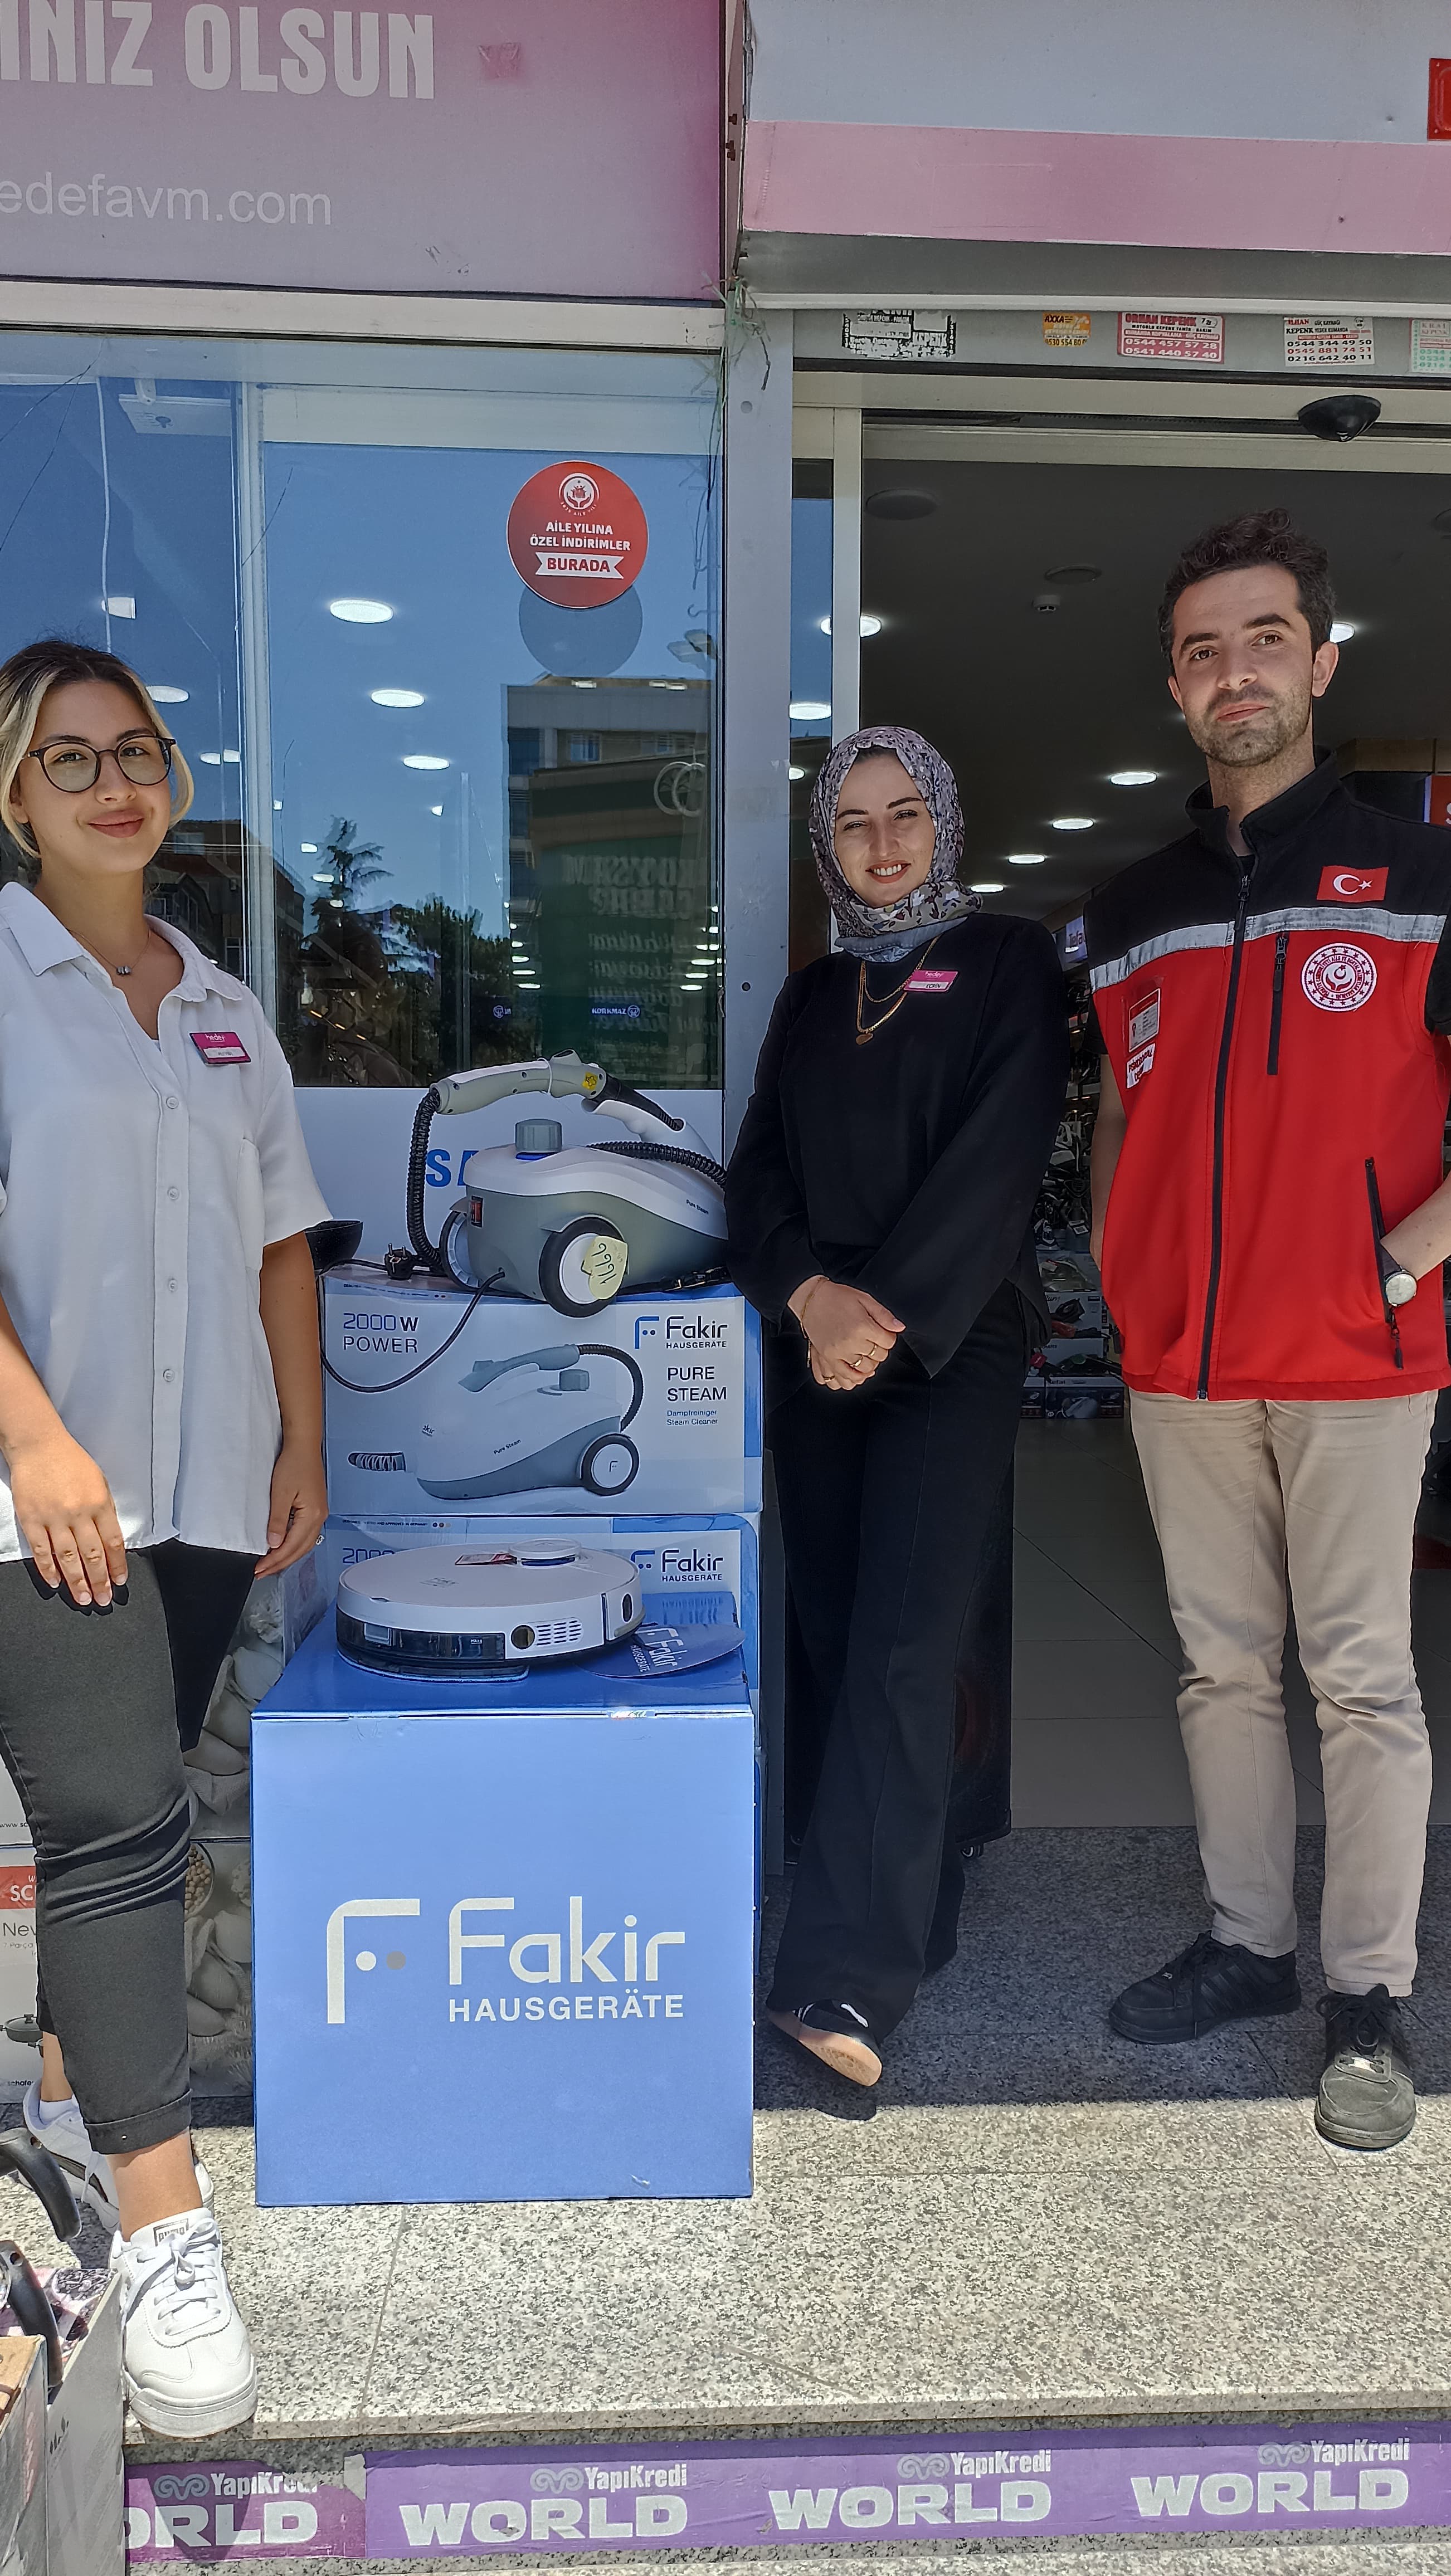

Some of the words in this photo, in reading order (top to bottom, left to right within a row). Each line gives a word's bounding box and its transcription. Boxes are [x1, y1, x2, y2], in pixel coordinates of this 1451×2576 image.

[184, 4, 435, 99] OLSUN
[546, 520, 572, 533] AİLE
[573, 522, 613, 535] YILINA
[530, 534, 559, 547] ÖZEL
[562, 535, 631, 551] İNDİRİMLER
[547, 558, 611, 573] BURADA
[343, 1313, 396, 1331] 2000
[400, 1316, 418, 1331] W
[666, 1315, 728, 1339] Fakir
[343, 1336, 417, 1353] POWER
[668, 1367, 715, 1380] PURE
[667, 1387, 727, 1402] STEAM
[493, 1446, 505, 1455] Pure
[505, 1438, 522, 1449] Steam
[343, 1548, 395, 1564] 200
[662, 1549, 723, 1573] Fakir
[10, 1884, 37, 1902] SC
[449, 1896, 685, 1985] Fakir
[450, 1988, 684, 2022] HAUSGERÄTE
[1309, 2437, 1410, 2466] YapıKredi
[950, 2449, 1051, 2479] YapıKredi
[584, 2464, 687, 2492] YapıKredi
[1131, 2468, 1409, 2517] WORLD
[768, 2480, 1052, 2530] WORLD
[399, 2494, 688, 2546] WORLD
